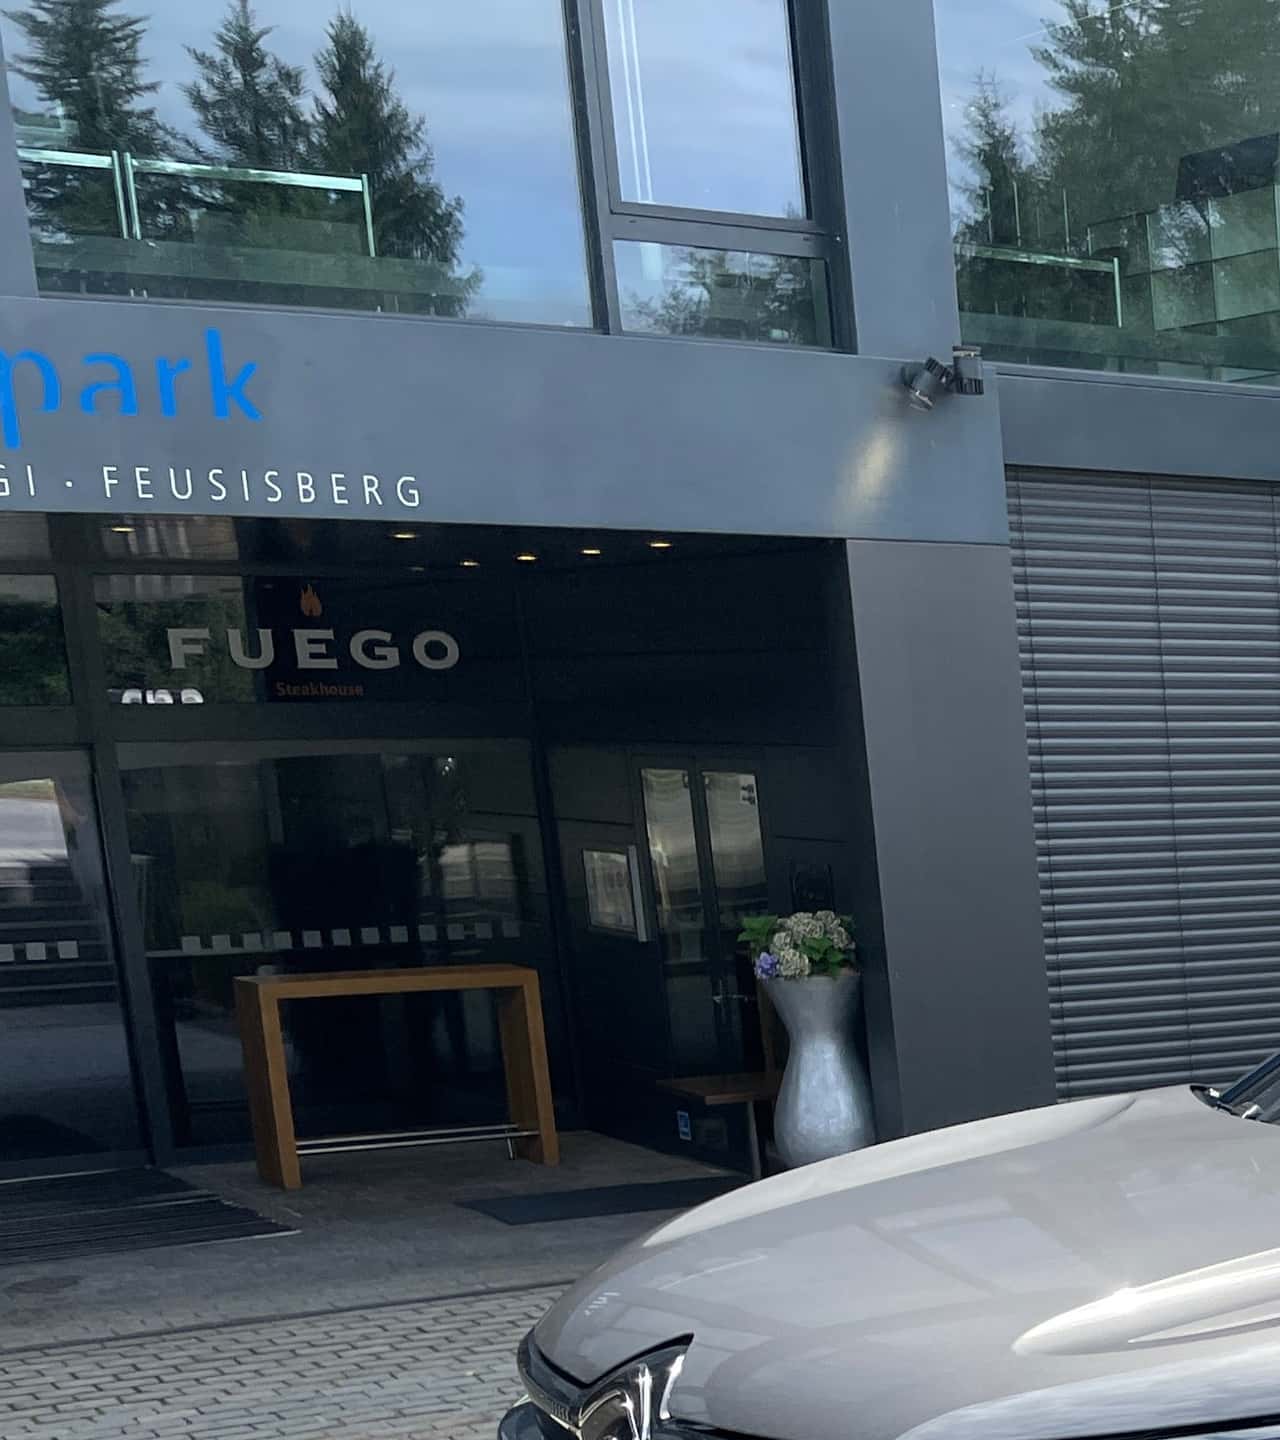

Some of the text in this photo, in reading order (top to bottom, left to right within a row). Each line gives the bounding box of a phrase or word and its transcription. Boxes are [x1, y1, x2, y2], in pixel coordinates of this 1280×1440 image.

[103, 464, 421, 507] FEUSISBERG
[166, 626, 460, 670] FUEGO
[275, 681, 365, 698] Steakhouse
